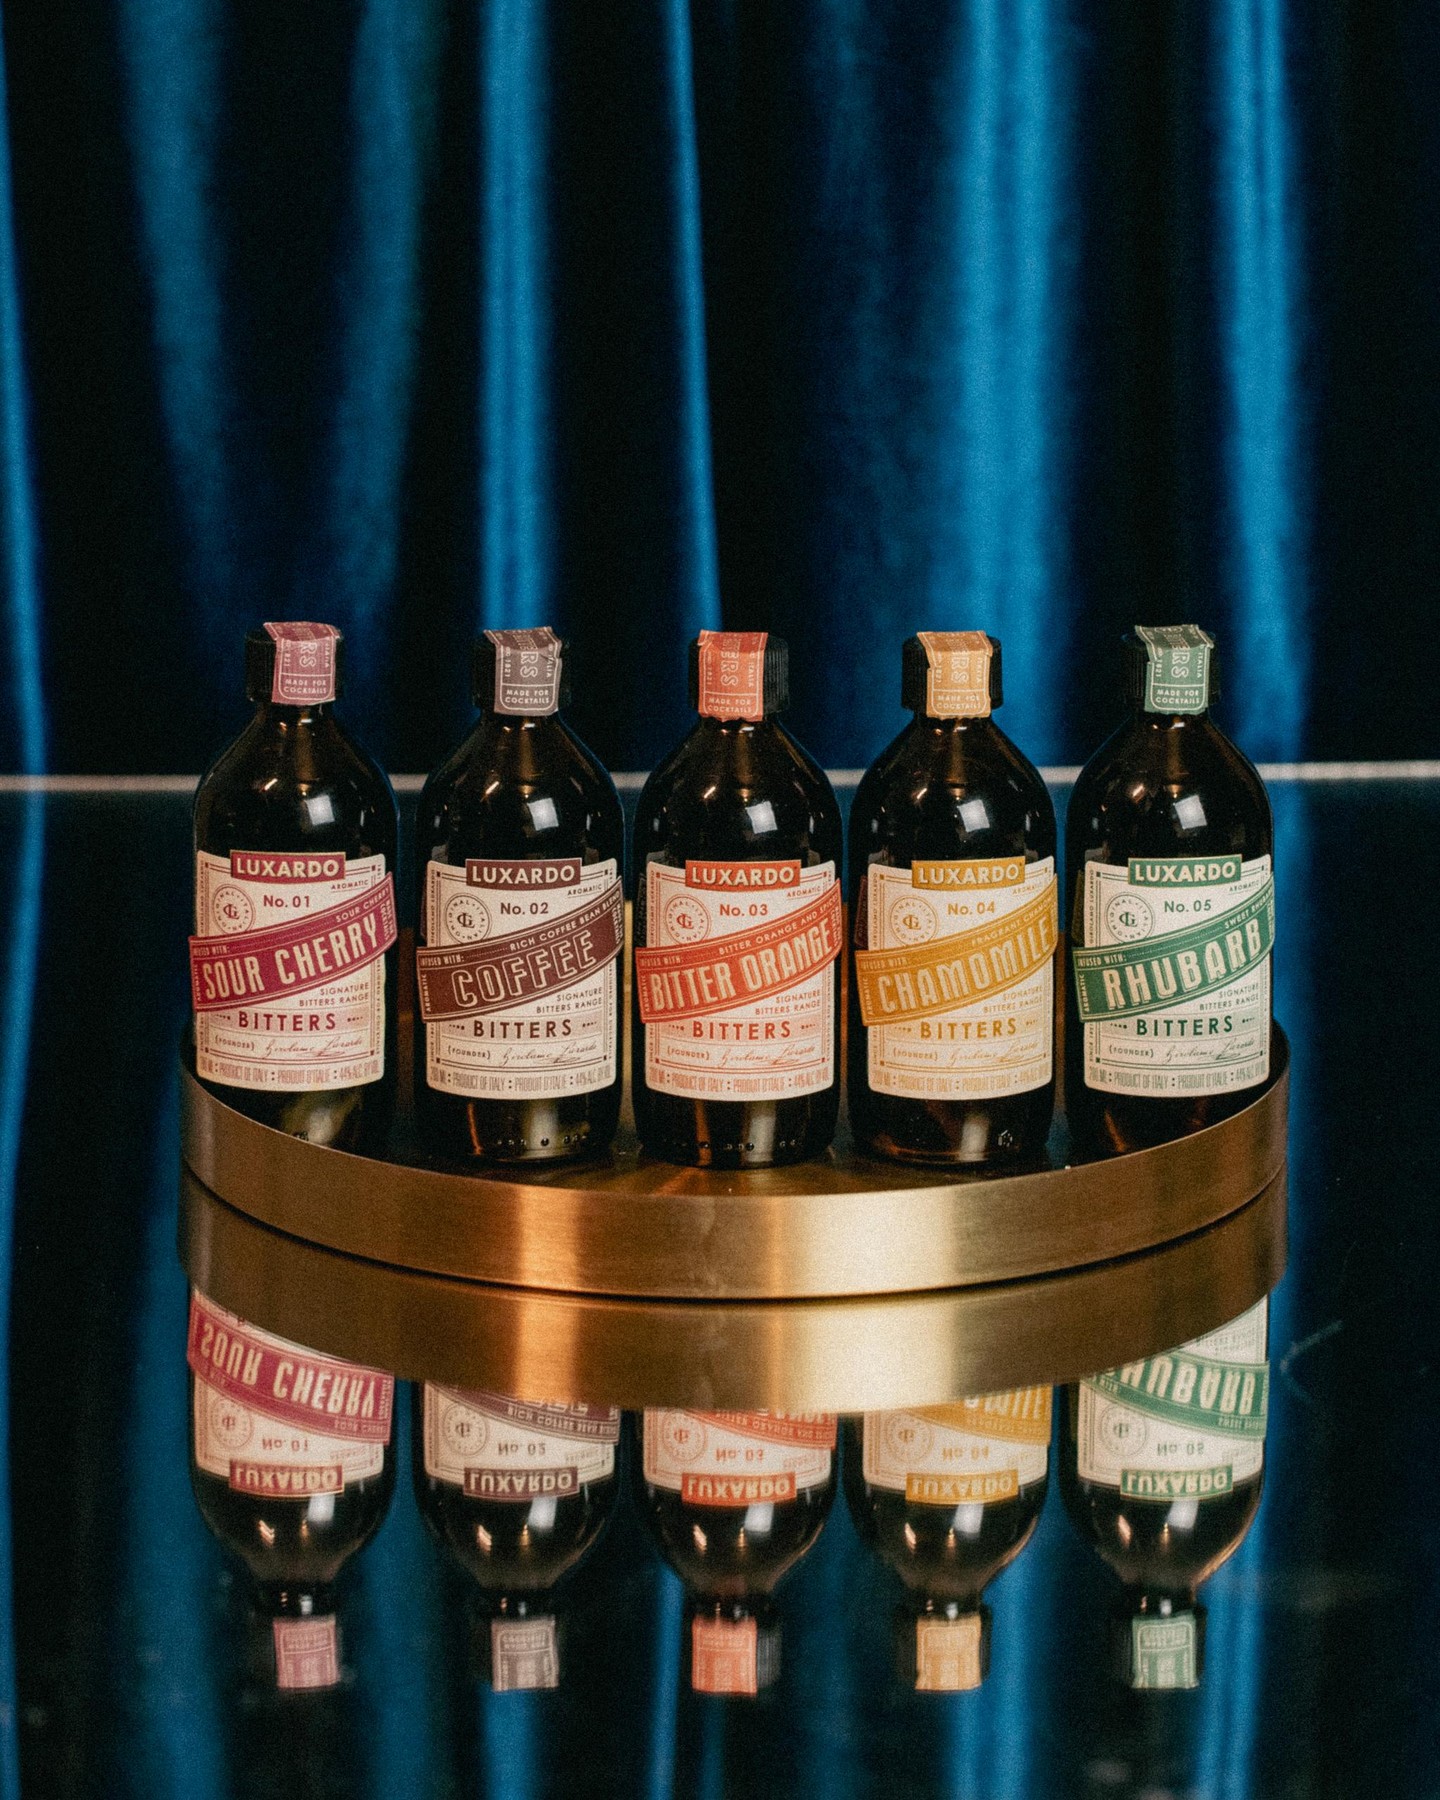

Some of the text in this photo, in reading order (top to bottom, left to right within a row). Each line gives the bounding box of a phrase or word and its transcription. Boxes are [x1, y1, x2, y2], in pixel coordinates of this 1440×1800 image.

[237, 858, 340, 878] LUXARDO
[472, 866, 575, 885] LUXARDO
[692, 866, 794, 886] LUXARDO
[918, 863, 1020, 885] LUXARDO
[1136, 862, 1236, 882] LUXARDO
[331, 880, 368, 890] AROMATIC
[567, 883, 603, 896] AROMATIC
[787, 886, 821, 898] AROMATIC
[264, 895, 310, 908] No. 01
[336, 887, 389, 922] SOUR CHERRY
[501, 903, 549, 915] No. 02
[720, 904, 768, 916] No. 03
[948, 902, 995, 916] No. 04
[1165, 900, 1211, 912] No. 05
[1225, 910, 1249, 929] SWEET
[510, 937, 535, 951] RICH
[539, 921, 577, 941] COFFEE
[580, 909, 601, 924] BEAN
[719, 940, 752, 955] BITTER
[755, 921, 797, 943] ORANGE
[800, 912, 817, 925] AND
[202, 913, 378, 1000] SOUR CHERRY
[650, 918, 832, 1011] BITTER ORANGE
[878, 916, 1050, 1013] CHAMOMILE
[1078, 954, 1127, 967] INFUSED WITH:
[1102, 918, 1261, 1010] RHUBARB
[451, 930, 597, 1008] COFFEE
[320, 982, 369, 995] SIGNATURE
[421, 974, 431, 1012] AROMATIC
[556, 987, 602, 1002] SIGNATURE
[775, 989, 820, 1004] SIGNATURE
[1080, 974, 1090, 1012] AROMATIC
[1219, 983, 1259, 998] SIGNATURE
[300, 992, 369, 1007] BITTERS RANGE
[536, 997, 602, 1014] BITTERS RANGE
[755, 1000, 820, 1015] BITTERS RANGE
[1200, 993, 1259, 1011] BITTERS RANGE
[238, 1011, 336, 1031] BITTERS
[474, 1019, 572, 1039] BITTERS
[920, 1018, 1016, 1039] BITTERS
[1136, 1016, 1233, 1036] BITTERS
[692, 1021, 791, 1040] BITTERS
[447, 1045, 491, 1059] (FOUNDER)
[667, 1046, 710, 1060] (FOUNDER)
[1109, 1045, 1154, 1058] (FOUNDER)
[490, 1077, 505, 1091] ITALY
